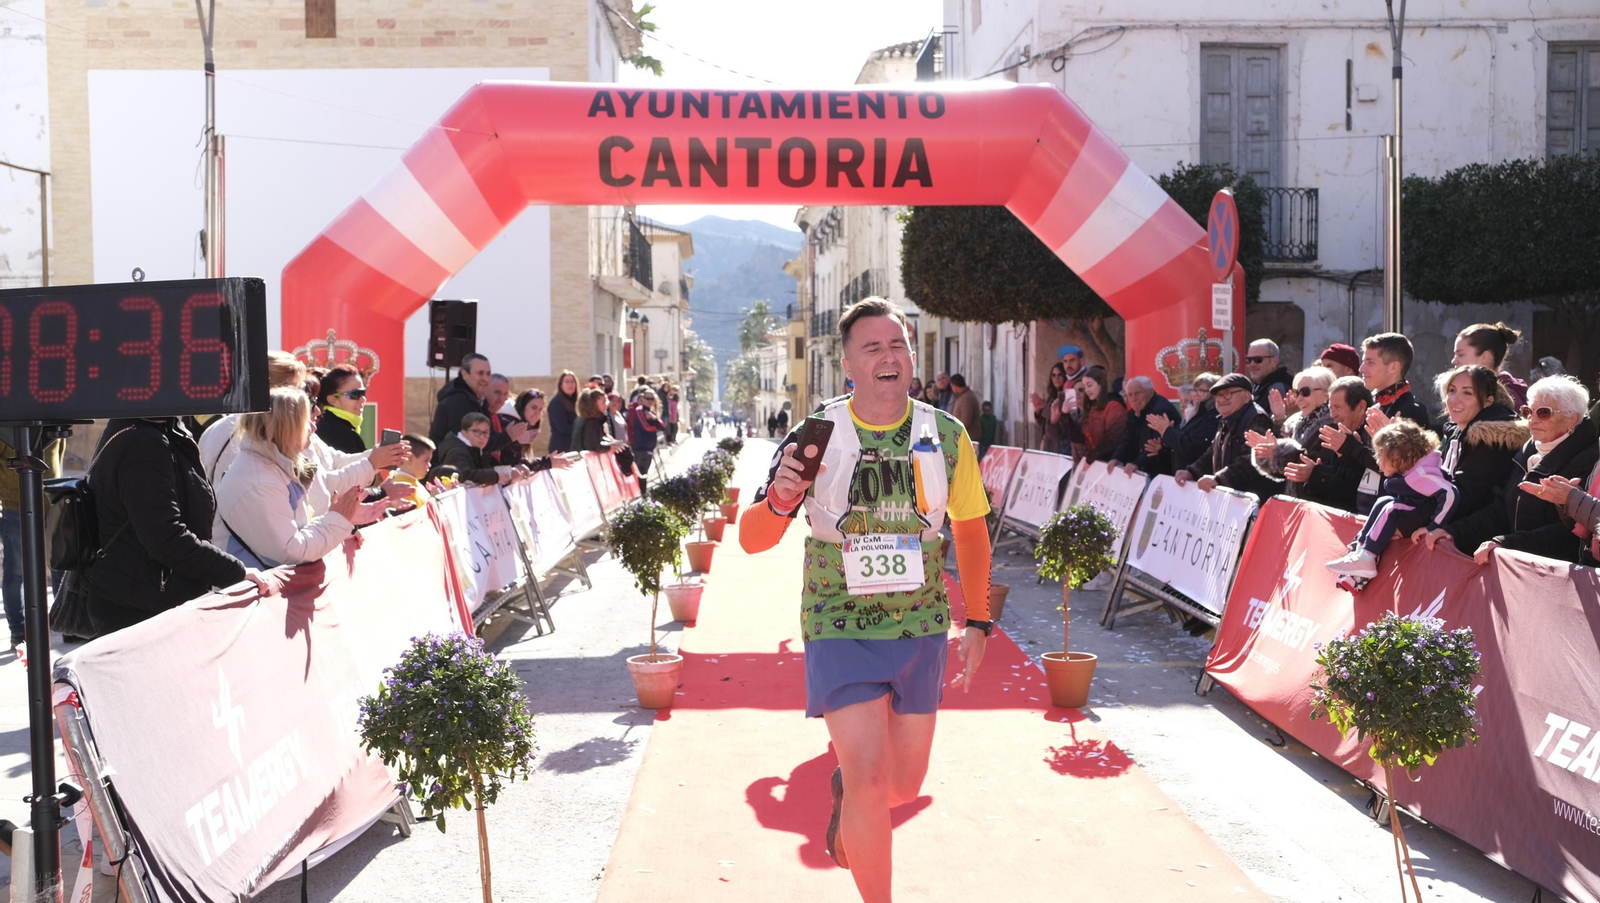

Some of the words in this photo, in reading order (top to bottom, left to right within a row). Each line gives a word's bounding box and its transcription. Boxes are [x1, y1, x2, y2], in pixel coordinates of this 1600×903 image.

[587, 90, 946, 120] AYUNTAMIENTO
[598, 135, 934, 189] CANTORIA
[0, 292, 231, 403] 8:36
[881, 500, 911, 522] UNA
[1226, 527, 1239, 544] DE
[852, 537, 861, 545] IV
[863, 536, 882, 545] CxM
[859, 553, 908, 578] 338
[1151, 521, 1231, 580] CANTORIA
[1243, 597, 1322, 653] TEAMERGY
[1533, 712, 1600, 783] TEA
[184, 728, 308, 867] TEAMERGY
